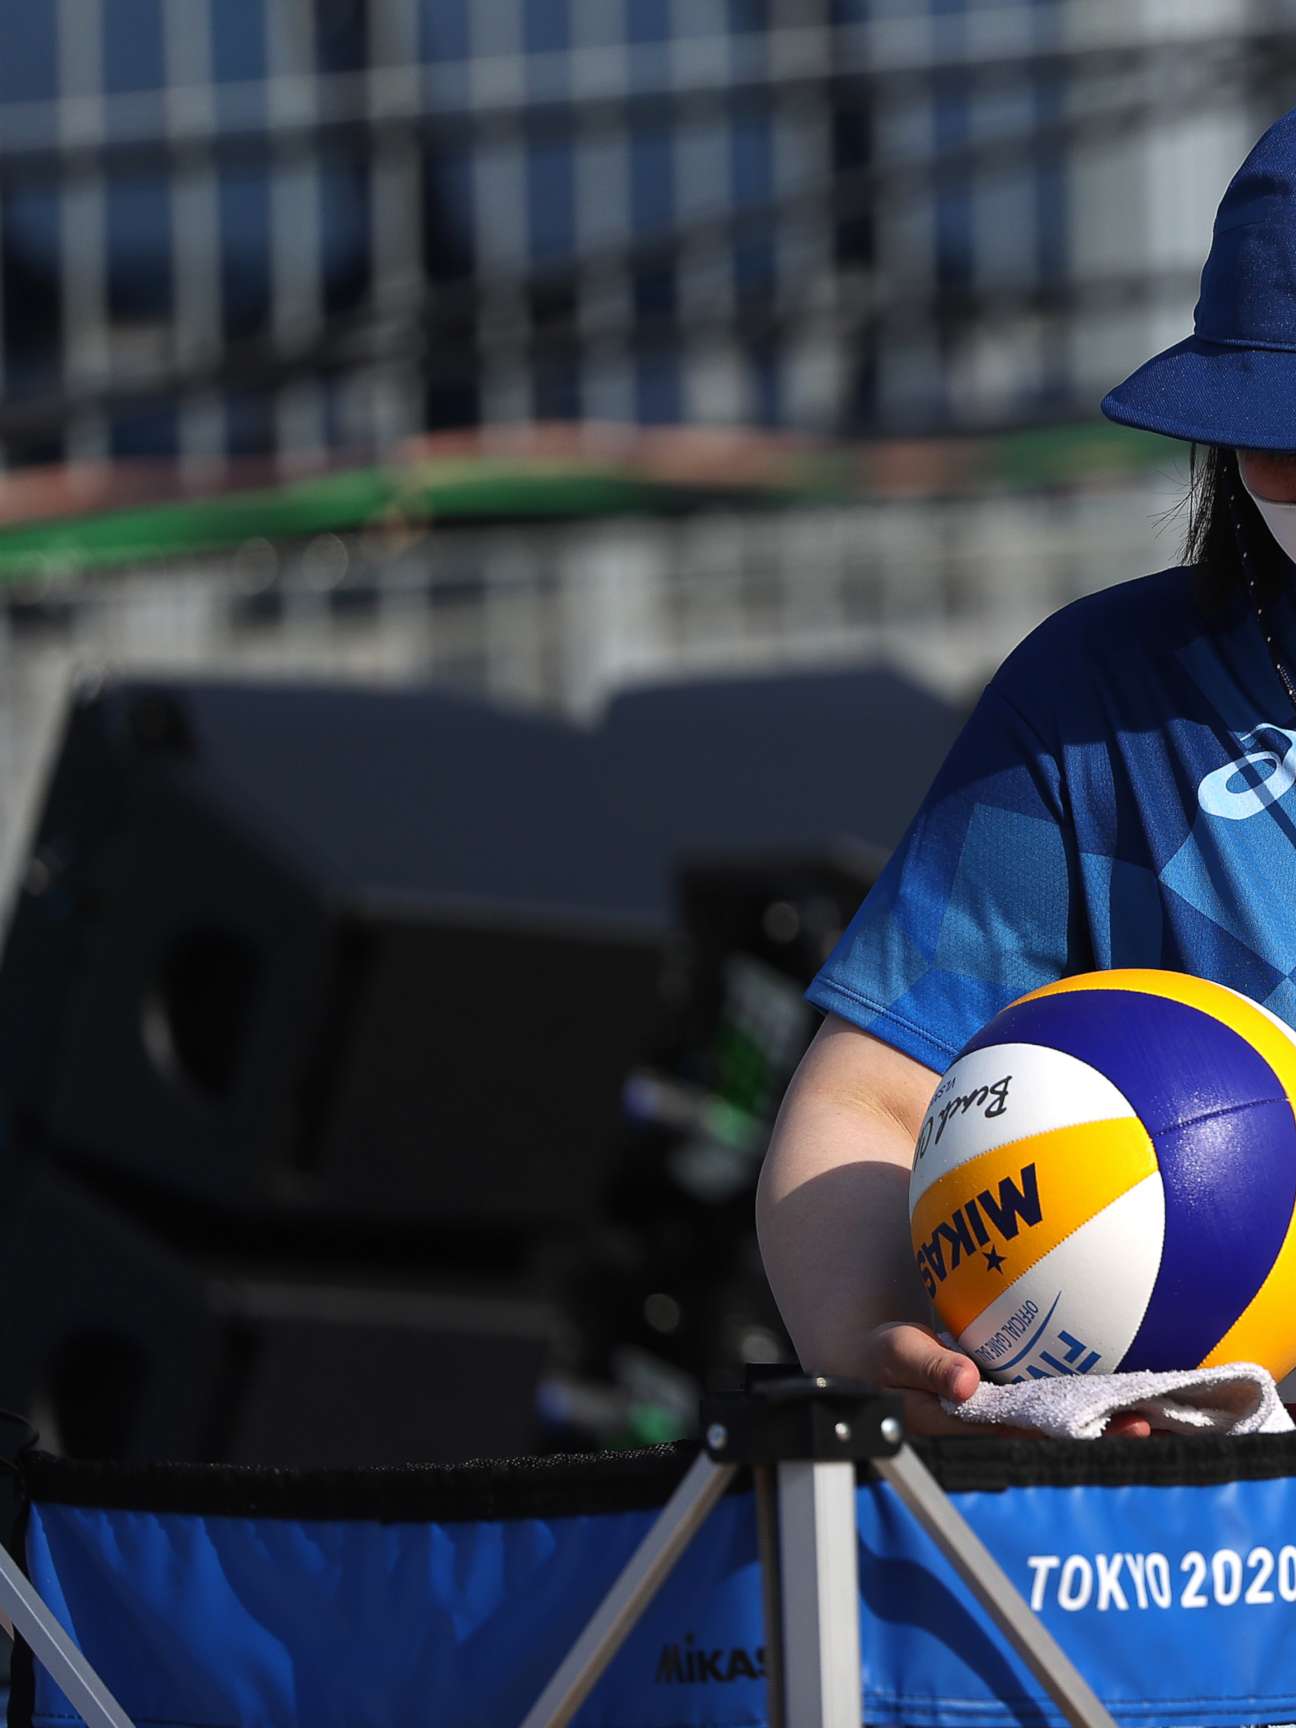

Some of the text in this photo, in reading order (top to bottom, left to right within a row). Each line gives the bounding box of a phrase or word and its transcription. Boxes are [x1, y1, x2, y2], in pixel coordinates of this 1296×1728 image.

[917, 1162, 1043, 1299] MIKAS
[1001, 1299, 1039, 1341] OFFICIAL
[984, 1332, 1013, 1360] GAME
[1027, 1552, 1172, 1612] TOKYO
